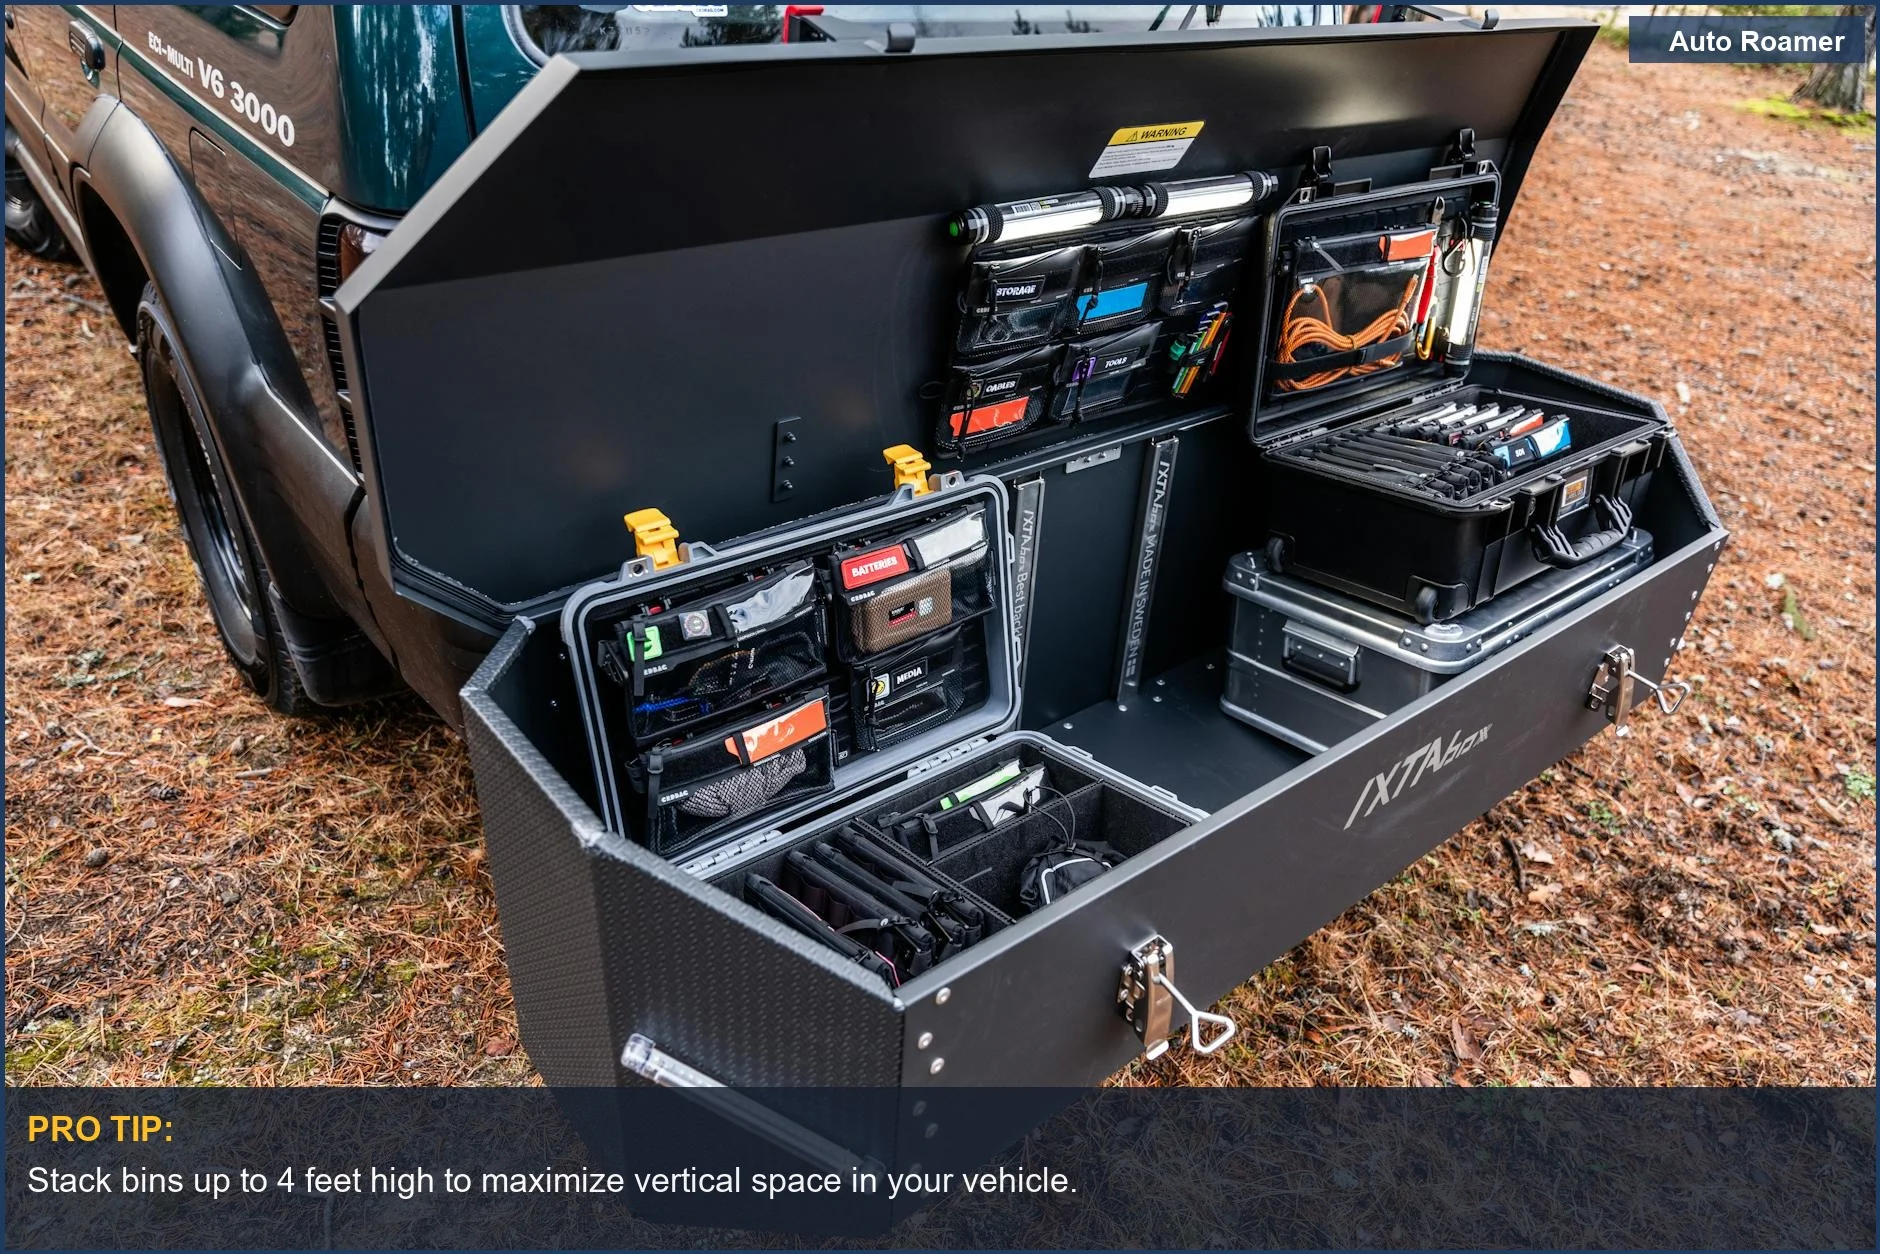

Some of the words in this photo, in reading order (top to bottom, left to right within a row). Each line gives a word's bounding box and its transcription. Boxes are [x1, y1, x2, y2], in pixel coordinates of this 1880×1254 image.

[148, 31, 194, 79] ECI-MULTI
[198, 57, 225, 99] V6
[230, 81, 295, 147] 3000
[1140, 127, 1187, 140] WARNING
[996, 284, 1036, 297] STORAGE
[1104, 356, 1128, 369] TOOLS
[1142, 534, 1157, 577] MADE
[851, 556, 899, 578] BATTERIES
[1014, 571, 1029, 603] Best
[1138, 578, 1152, 596] IN
[1130, 596, 1146, 659] SWEDEN
[896, 666, 923, 685] MEDIA
